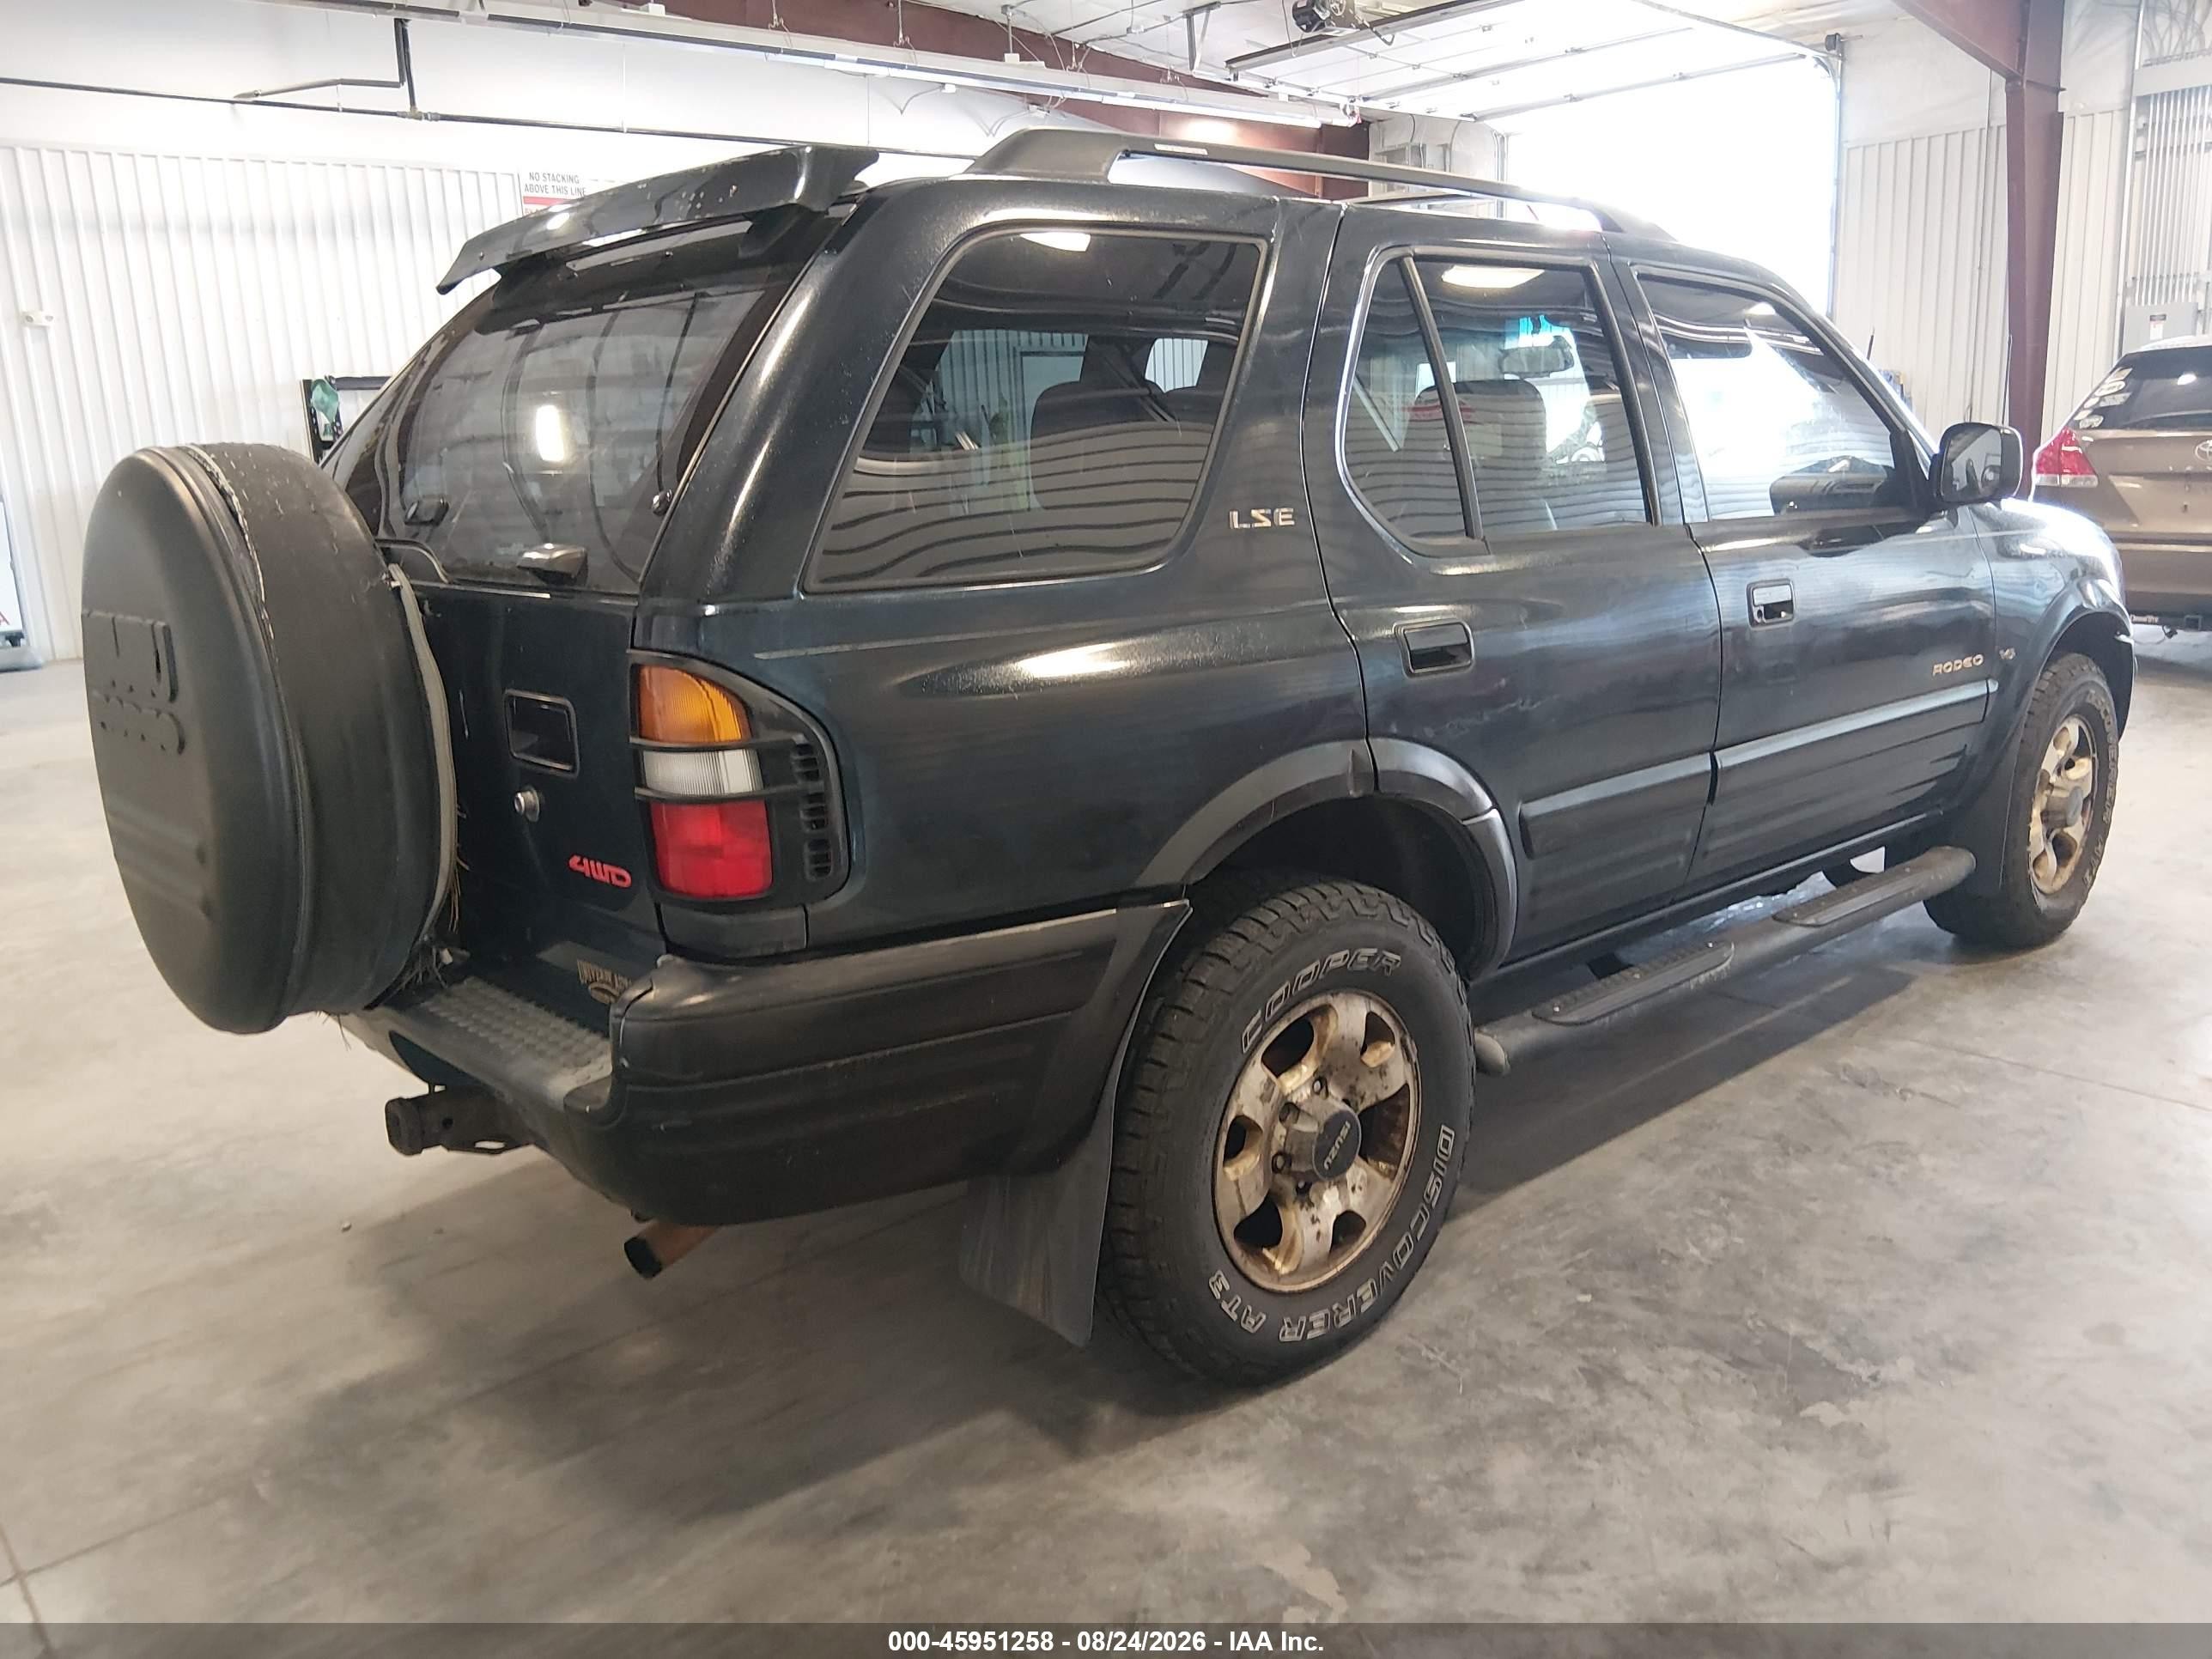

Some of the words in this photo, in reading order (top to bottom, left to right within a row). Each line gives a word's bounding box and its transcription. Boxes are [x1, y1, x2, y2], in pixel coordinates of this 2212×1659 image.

[525, 184, 549, 194] ABOVE
[551, 185, 568, 195] THIS
[529, 172, 539, 181] NO
[542, 173, 580, 184] STACKING
[1229, 507, 1295, 529] LSE
[1933, 653, 1984, 676] RODEO
[568, 855, 632, 888] 4WD
[1241, 948, 1402, 1054] COOPER
[1323, 1120, 1352, 1170] ISUZU
[1278, 1125, 1455, 1343] DISCOVERER
[1207, 1269, 1267, 1334] AT3
